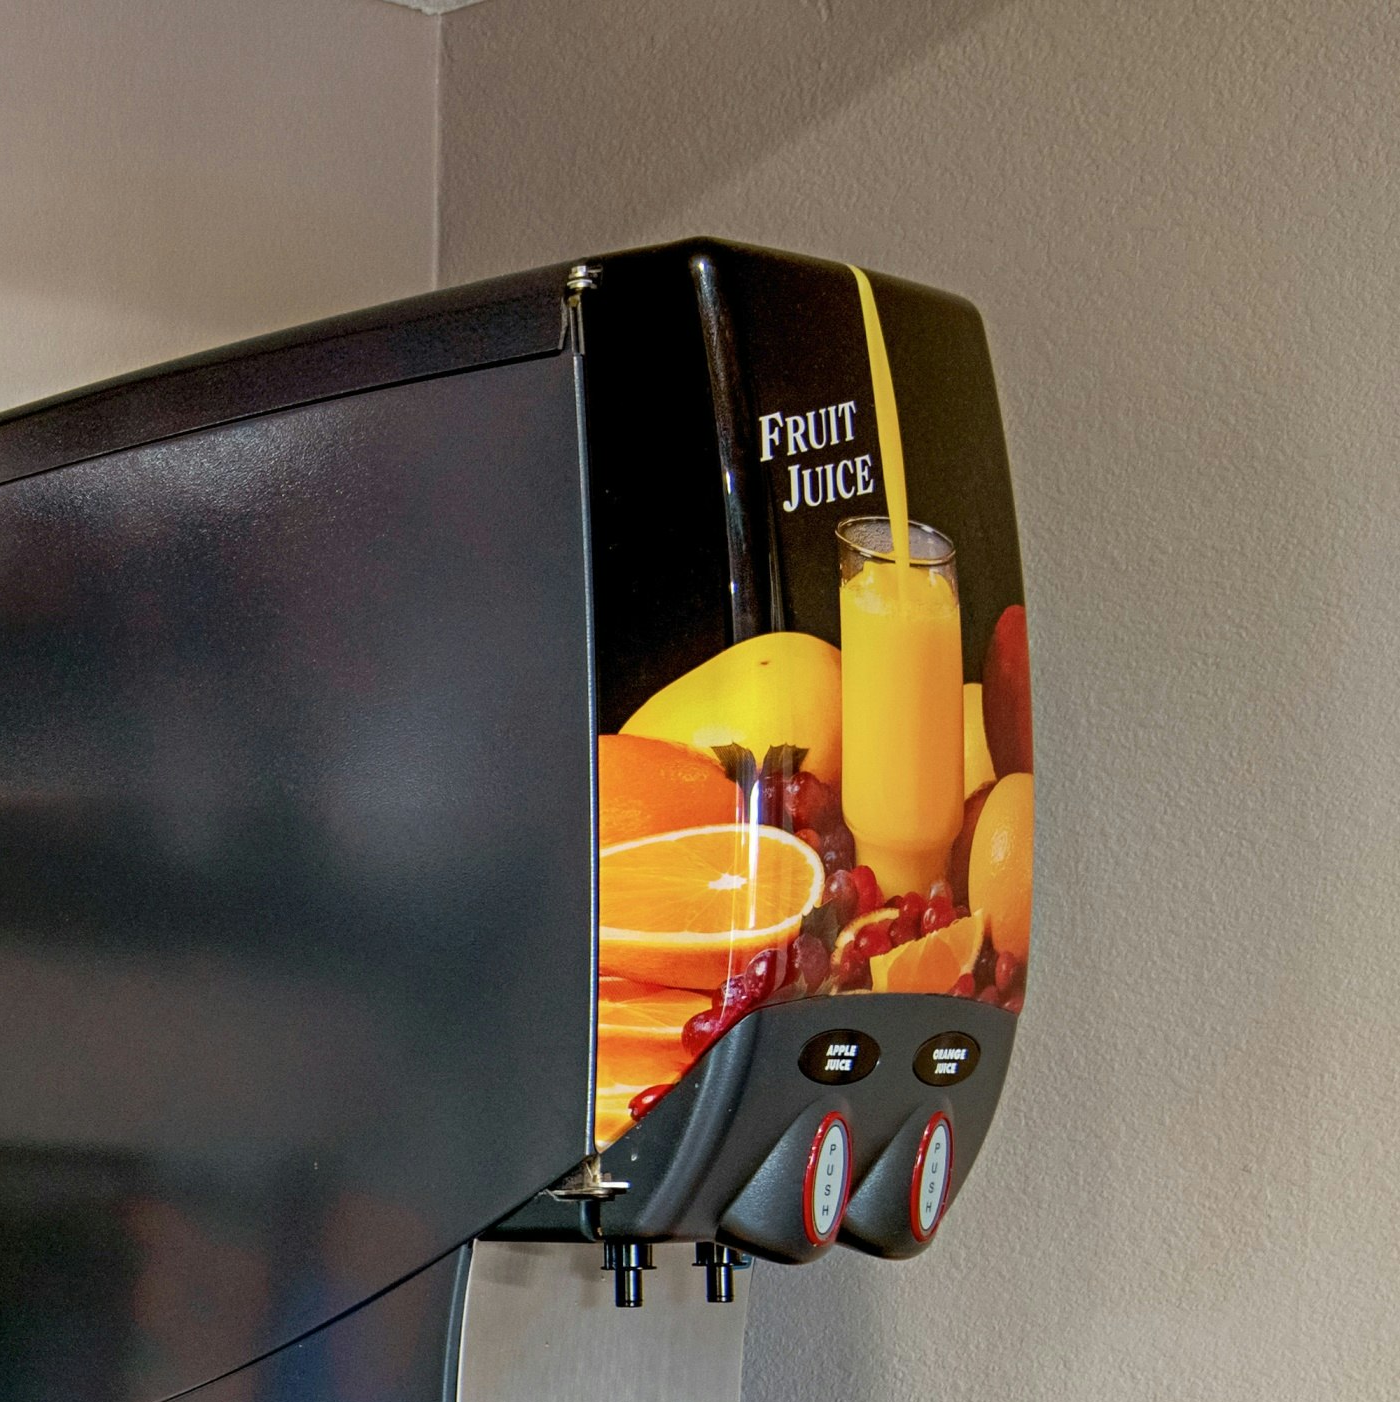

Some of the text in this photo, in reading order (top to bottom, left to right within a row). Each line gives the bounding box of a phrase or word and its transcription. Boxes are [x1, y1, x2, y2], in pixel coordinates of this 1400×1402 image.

[758, 400, 856, 462] FRUIT
[782, 454, 875, 513] JUICE
[825, 1059, 853, 1071] JUICE
[826, 1044, 858, 1057] APPLE
[932, 1049, 968, 1060] ORANGE
[934, 1062, 959, 1074] JUICE
[822, 1143, 837, 1217] PUSH
[925, 1142, 940, 1214] PUSH
